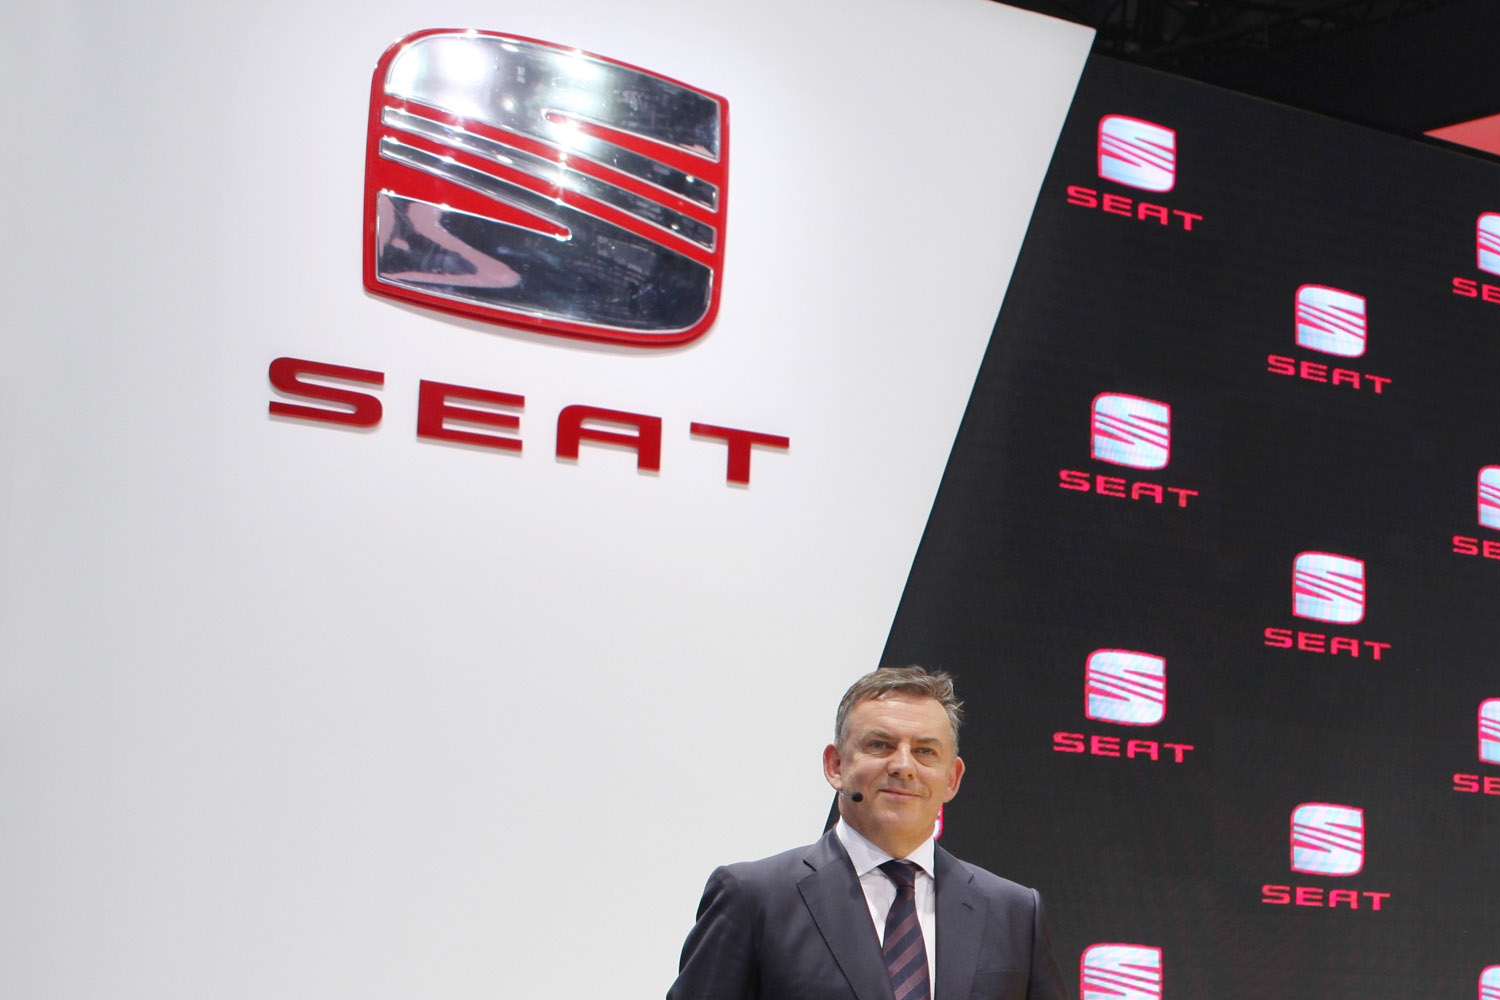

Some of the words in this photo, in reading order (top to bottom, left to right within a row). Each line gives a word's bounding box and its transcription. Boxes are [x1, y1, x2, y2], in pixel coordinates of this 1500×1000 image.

[1067, 184, 1203, 231] SEAT
[1268, 354, 1392, 394] SEAT
[268, 355, 790, 486] SEAT
[1059, 469, 1199, 508] SEAT
[1264, 627, 1391, 661] SEAT
[1053, 731, 1195, 764] SEAT
[1262, 884, 1390, 911] SEAT
